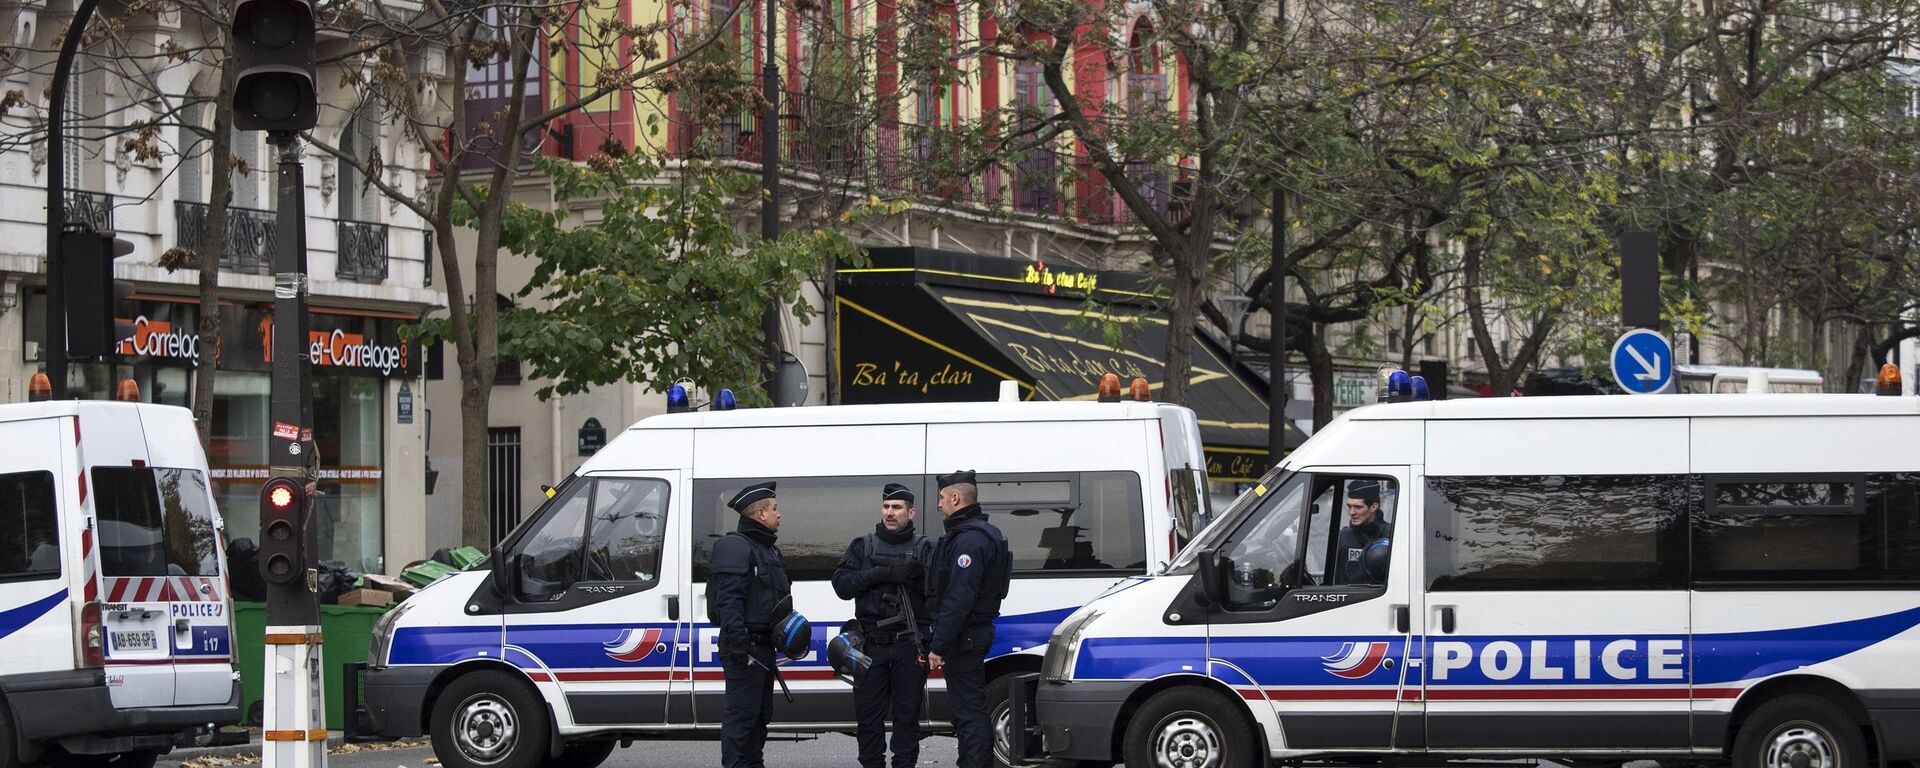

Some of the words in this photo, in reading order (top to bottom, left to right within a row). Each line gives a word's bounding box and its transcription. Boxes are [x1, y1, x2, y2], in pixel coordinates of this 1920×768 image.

[577, 586, 624, 594] TRANSIT
[1294, 594, 1348, 602] TRANSIT
[102, 603, 128, 611] TRANSIT
[173, 604, 212, 617] POLICE
[209, 638, 219, 652] 17
[1432, 639, 1683, 681] POLICE
